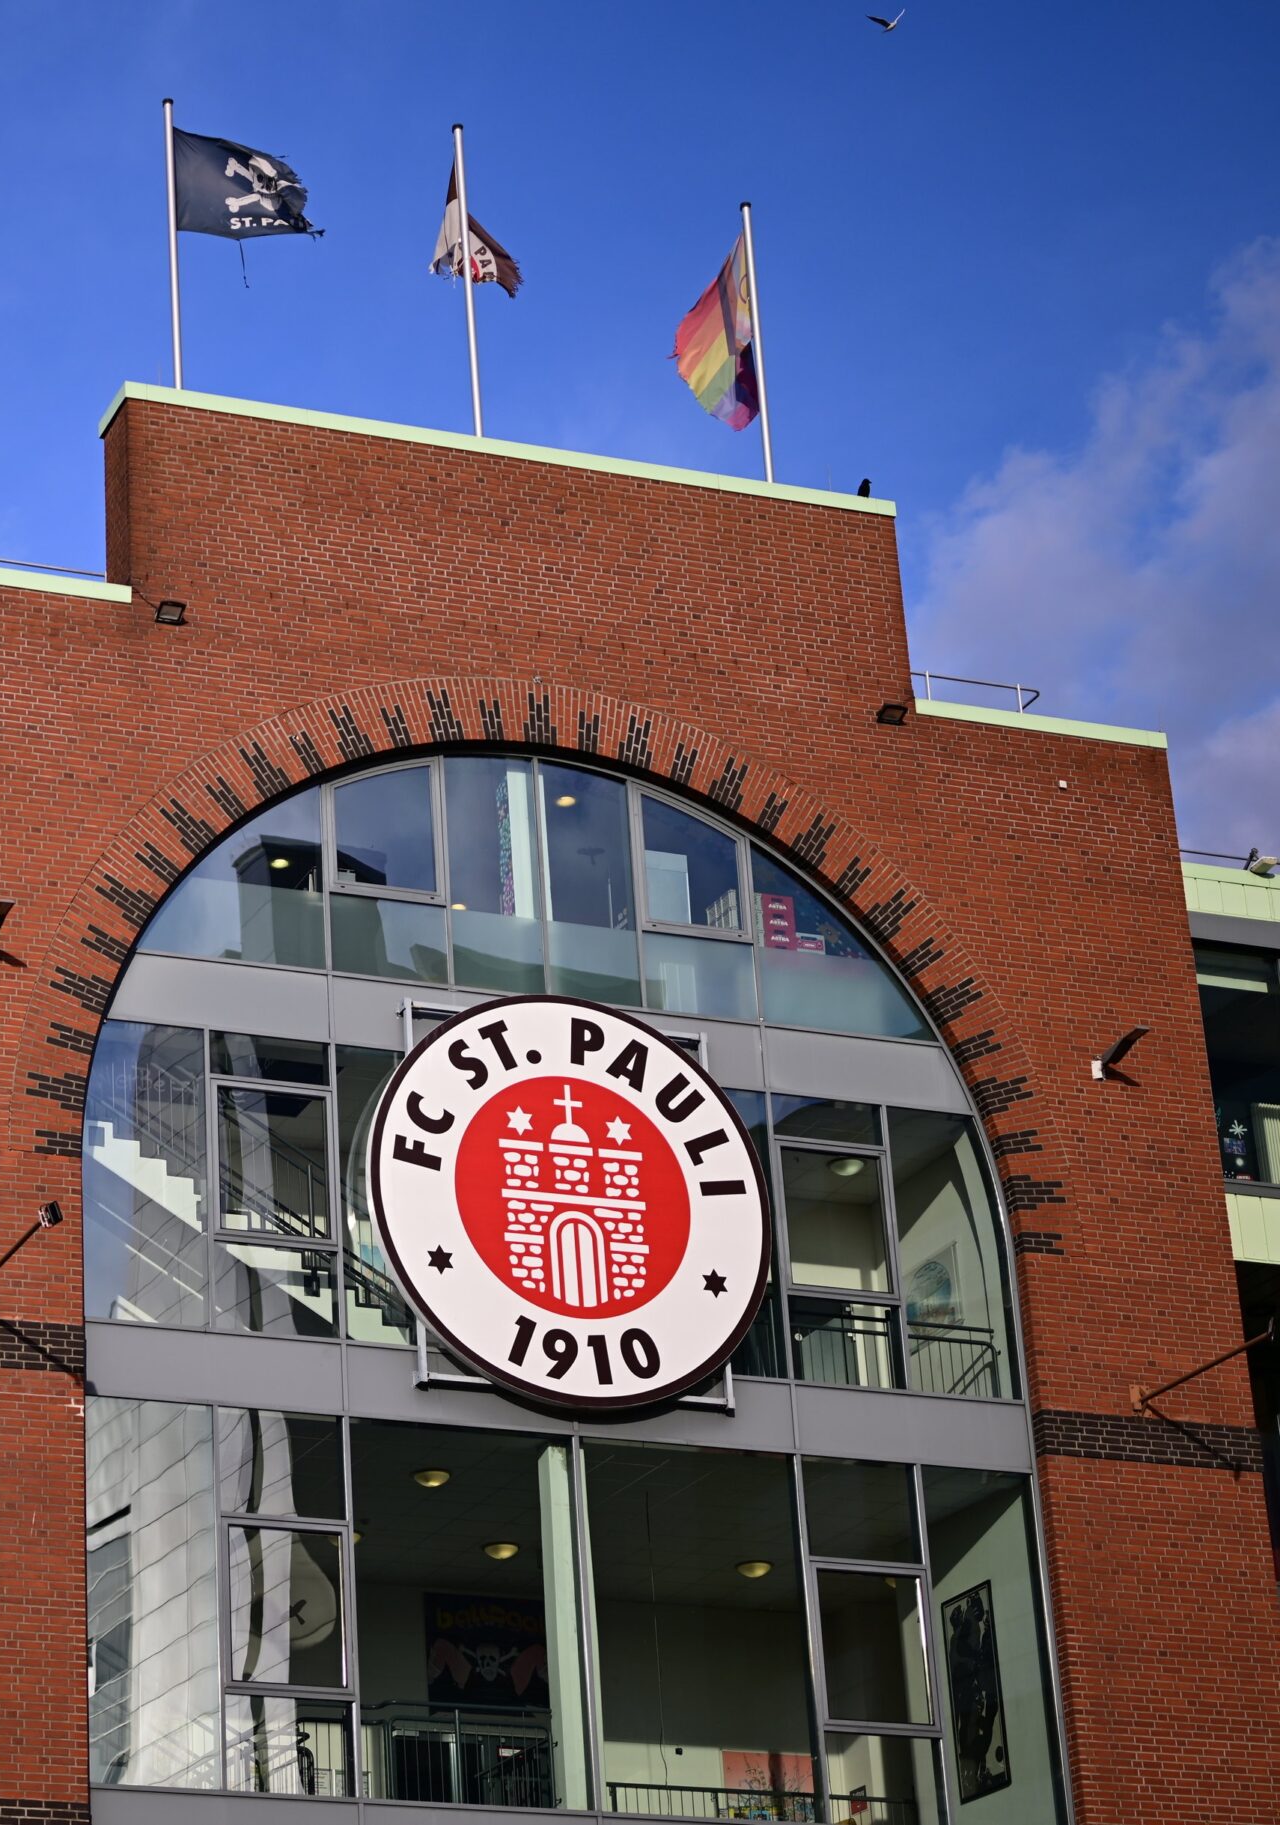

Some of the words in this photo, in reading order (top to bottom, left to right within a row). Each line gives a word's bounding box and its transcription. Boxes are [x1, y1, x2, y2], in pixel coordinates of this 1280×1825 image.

[230, 217, 257, 230] ST.
[392, 1090, 455, 1172] FC
[447, 1019, 542, 1091] ST.
[570, 1017, 747, 1196] PAULI
[507, 1314, 661, 1385] 1910
